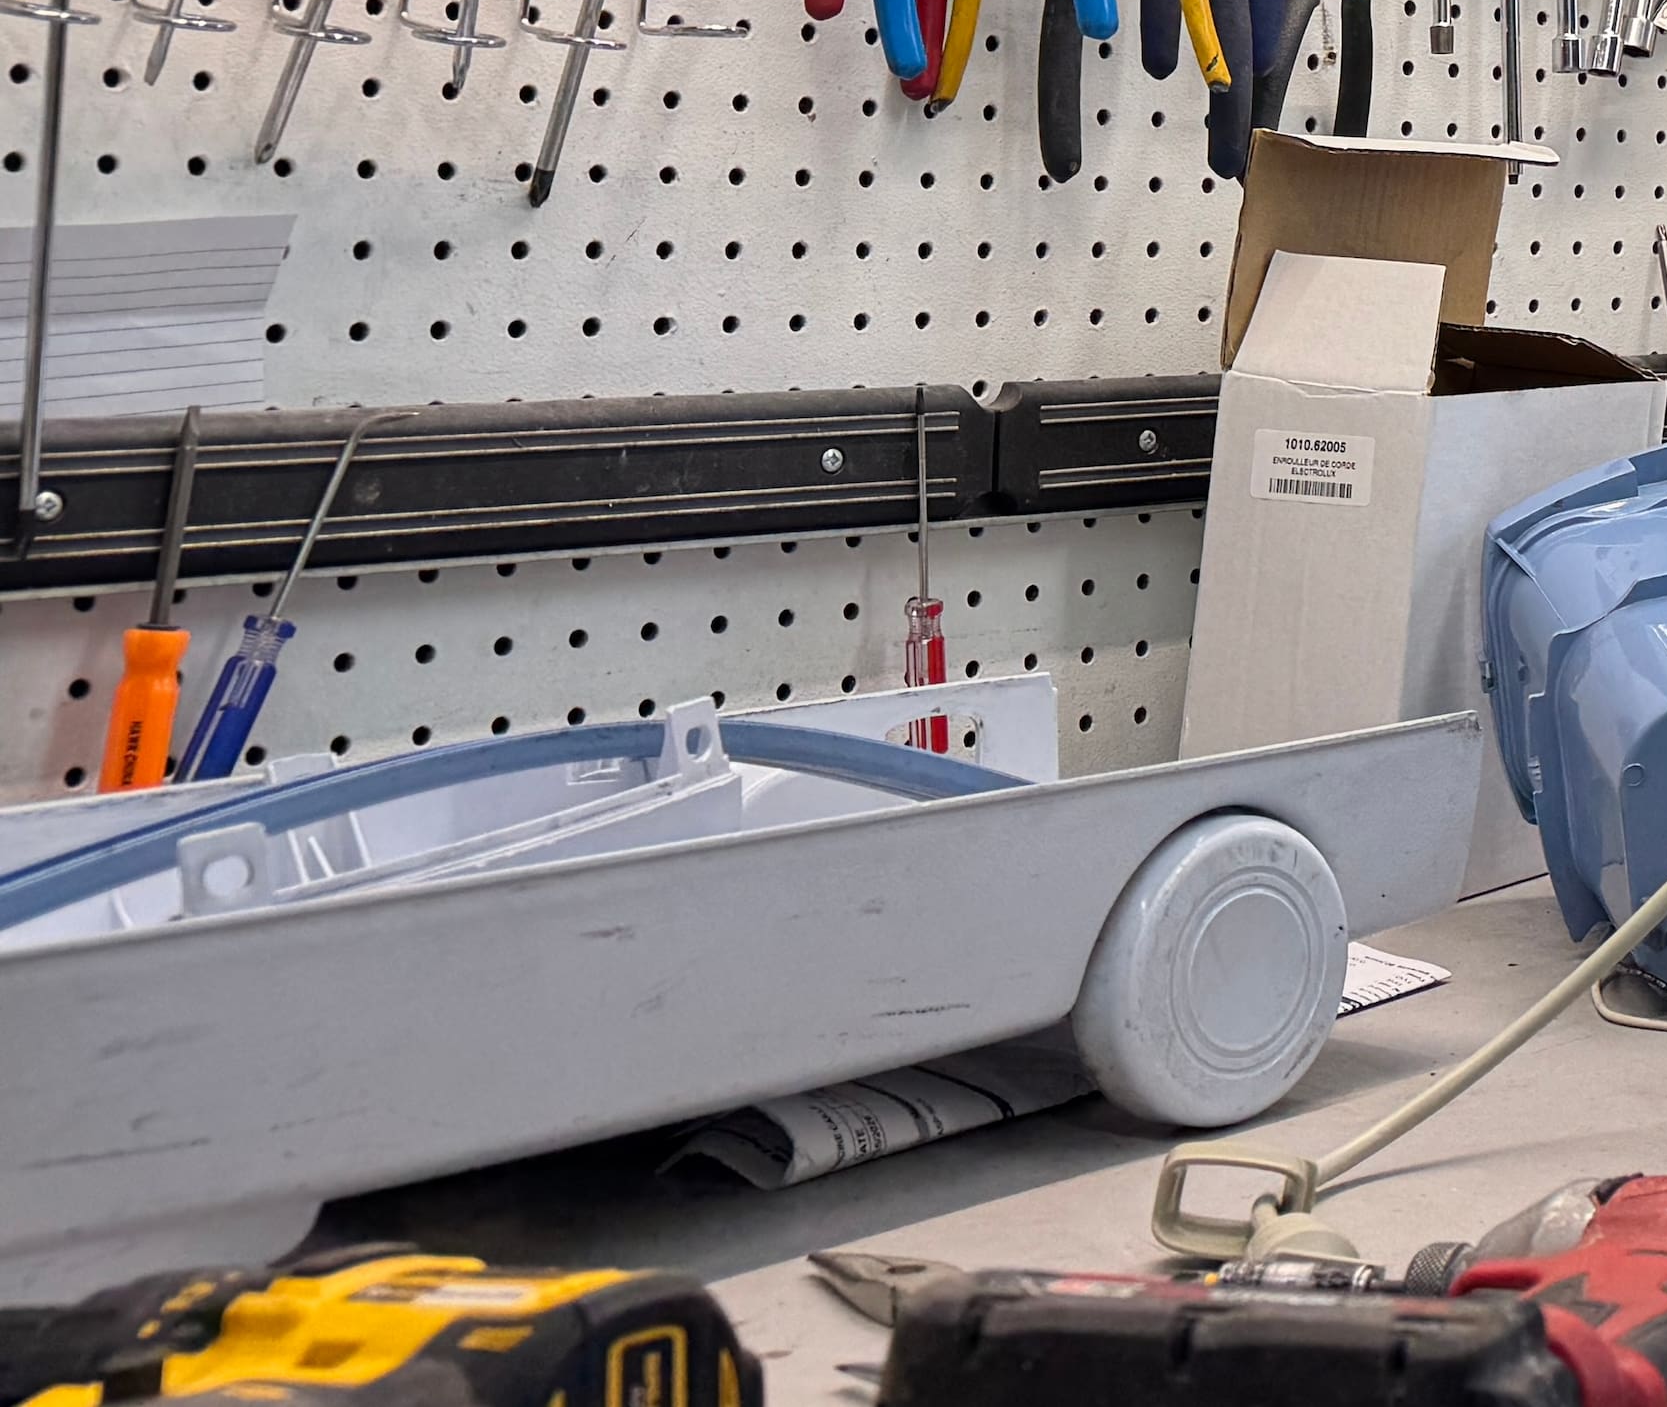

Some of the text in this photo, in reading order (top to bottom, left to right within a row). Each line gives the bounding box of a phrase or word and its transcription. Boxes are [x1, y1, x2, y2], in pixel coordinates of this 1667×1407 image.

[1285, 438, 1347, 453] 1010.62005
[1320, 460, 1329, 468] DE
[1331, 461, 1356, 470] CORDE
[1291, 467, 1337, 477] ELECTROLUX
[854, 1127, 867, 1157] ATE
